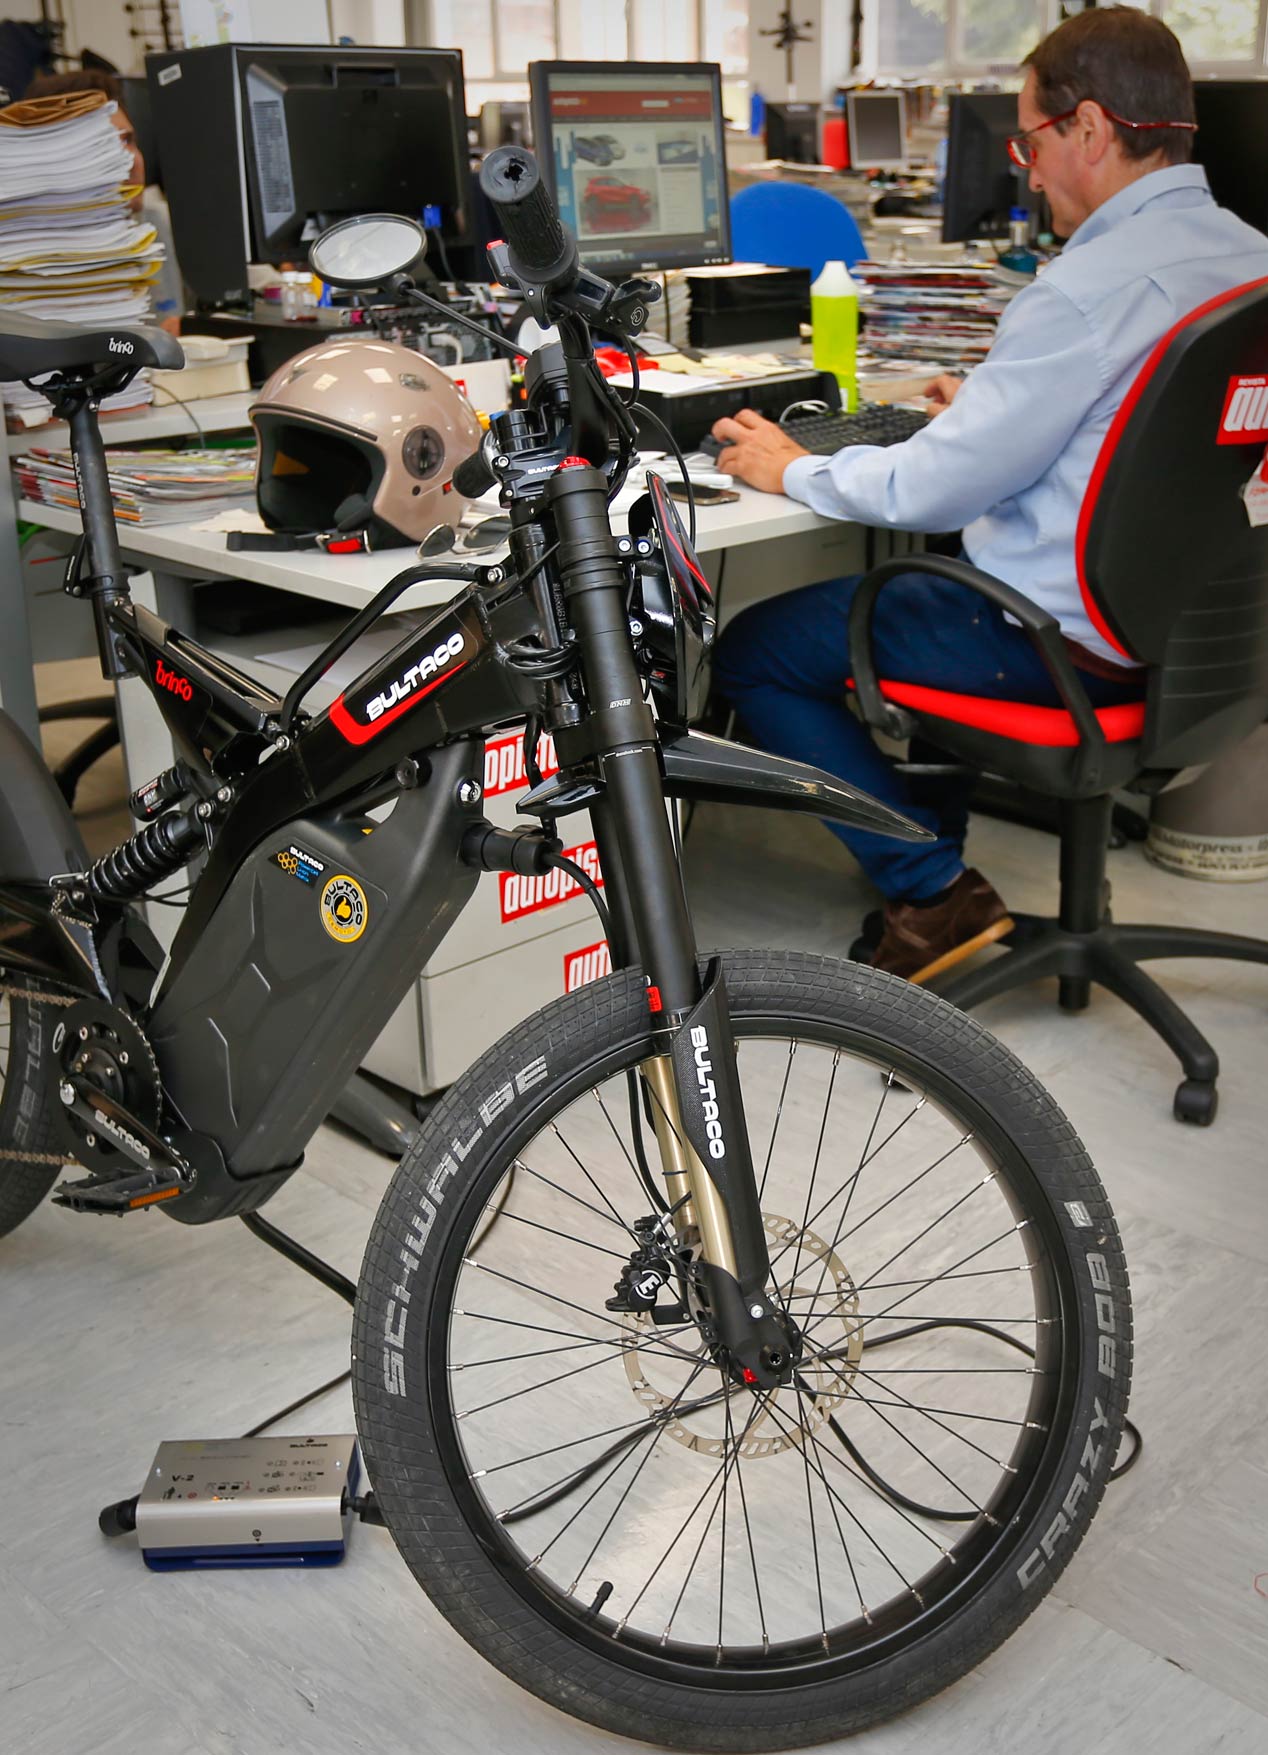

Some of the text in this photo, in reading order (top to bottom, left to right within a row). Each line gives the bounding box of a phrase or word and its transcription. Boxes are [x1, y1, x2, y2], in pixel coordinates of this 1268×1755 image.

[73, 452, 86, 510] BULTACO
[156, 659, 193, 701] brinco
[366, 633, 465, 722] BULTACO
[289, 846, 324, 871] BULTACO
[324, 881, 363, 925] BULTACO
[690, 1024, 726, 1159] BULTACO
[95, 1109, 151, 1160] BULTACO
[384, 1054, 549, 1397] SCHWALBE
[1016, 1252, 1116, 1590] CRAZY BOB
